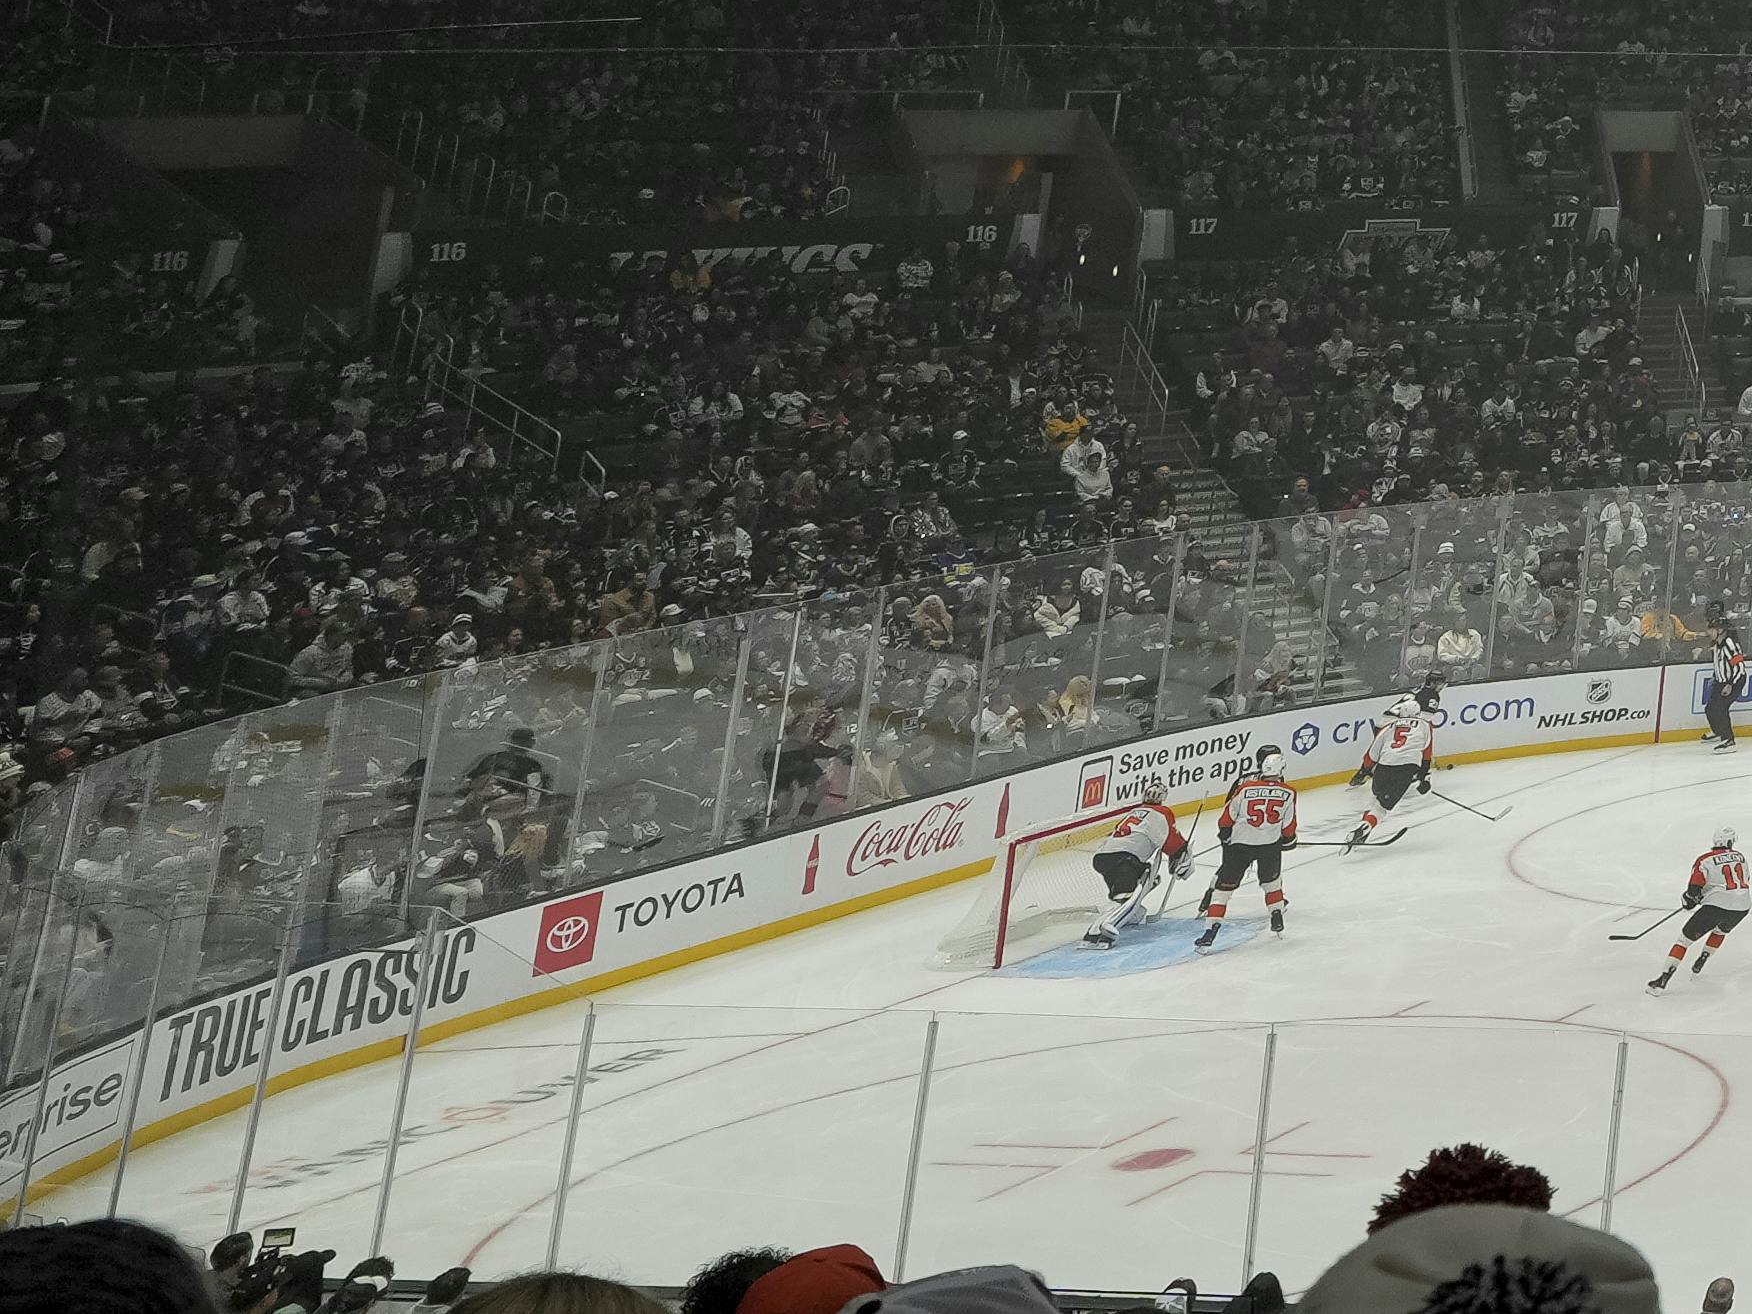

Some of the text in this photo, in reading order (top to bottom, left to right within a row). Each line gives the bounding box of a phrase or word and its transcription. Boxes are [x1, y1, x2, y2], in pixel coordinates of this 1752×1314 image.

[430, 241, 468, 264] 116
[1119, 731, 1252, 775] Save money
[1168, 753, 1254, 787] the app
[1246, 799, 1282, 828] 55
[1722, 863, 1749, 891] 11
[614, 872, 745, 934] TOYOTA
[160, 926, 477, 1103] TRUE CLASSIC
